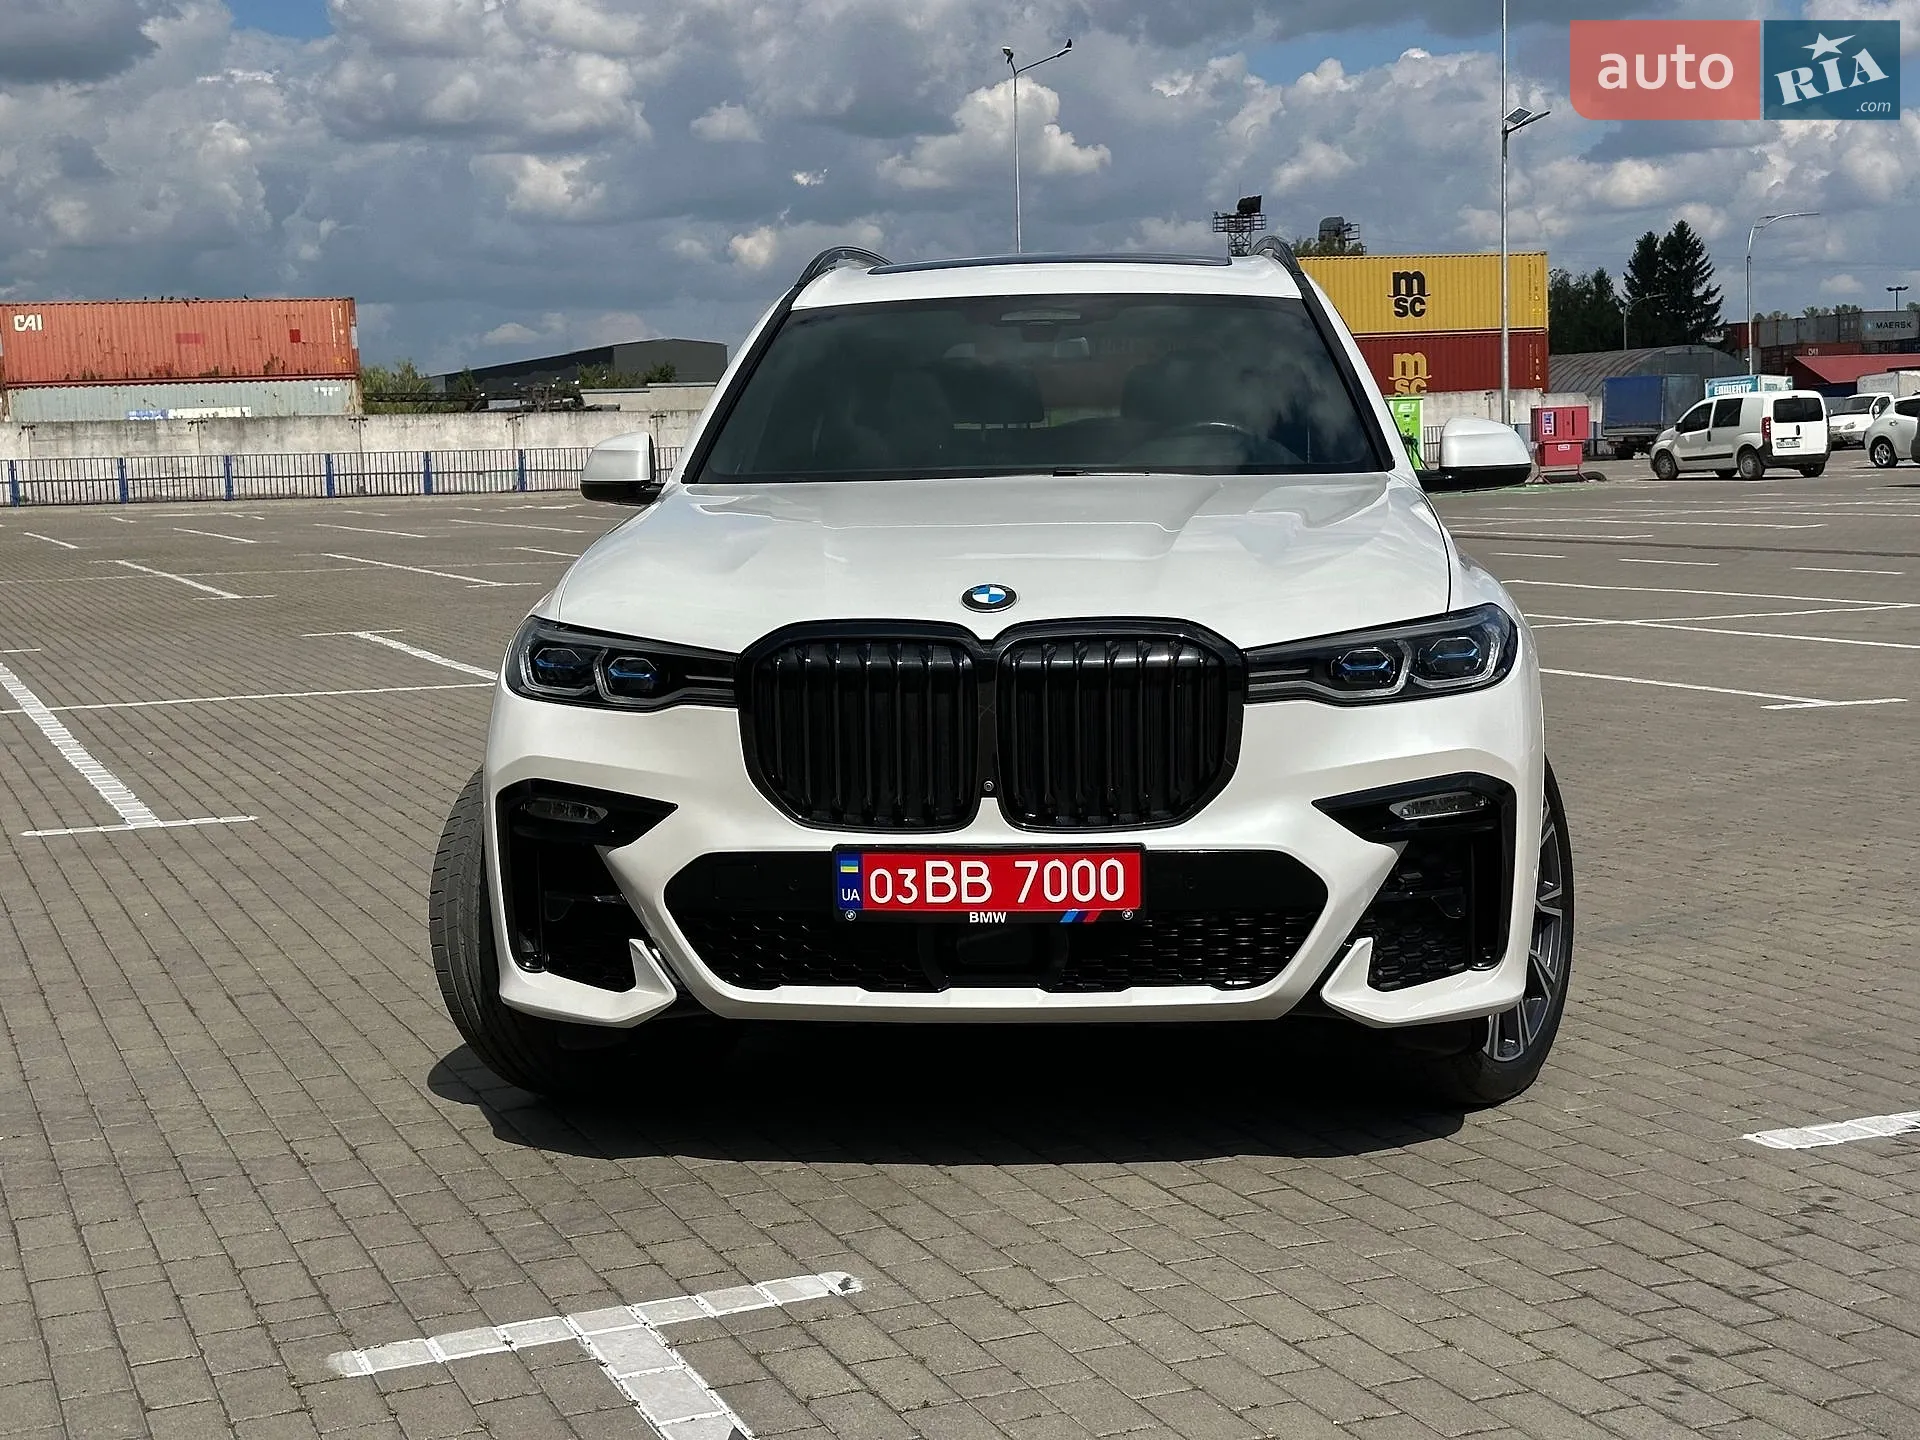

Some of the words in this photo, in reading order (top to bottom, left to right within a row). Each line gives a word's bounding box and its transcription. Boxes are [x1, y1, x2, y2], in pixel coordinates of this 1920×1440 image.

[14, 314, 43, 332] CAI
[1876, 321, 1912, 329] MAERSK
[1014, 858, 1125, 904] 7000
[841, 888, 861, 902] UA
[969, 912, 1007, 924] BMW
